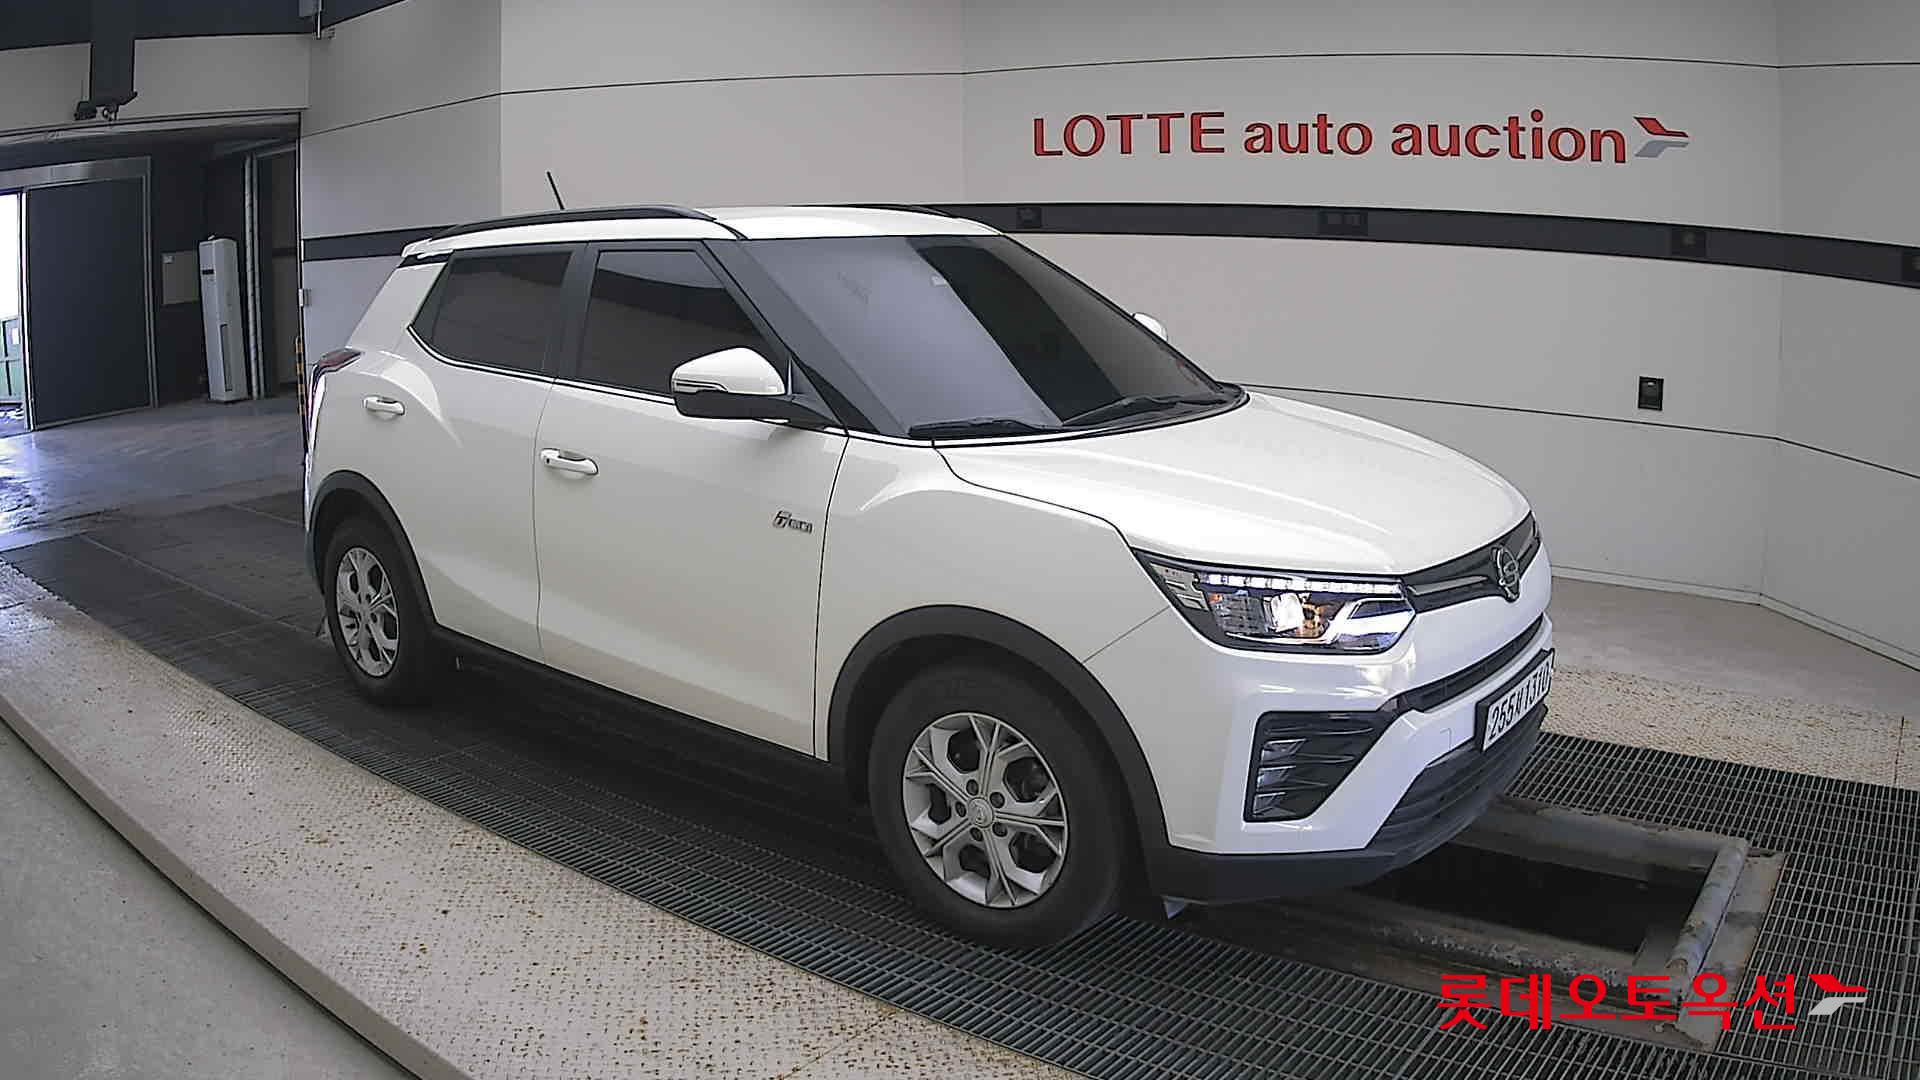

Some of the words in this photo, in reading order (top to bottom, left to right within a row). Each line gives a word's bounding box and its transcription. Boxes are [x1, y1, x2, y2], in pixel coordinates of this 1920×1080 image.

[1033, 112, 1225, 157] LOTTE
[1244, 113, 1373, 156] auto
[1391, 109, 1627, 164] auction
